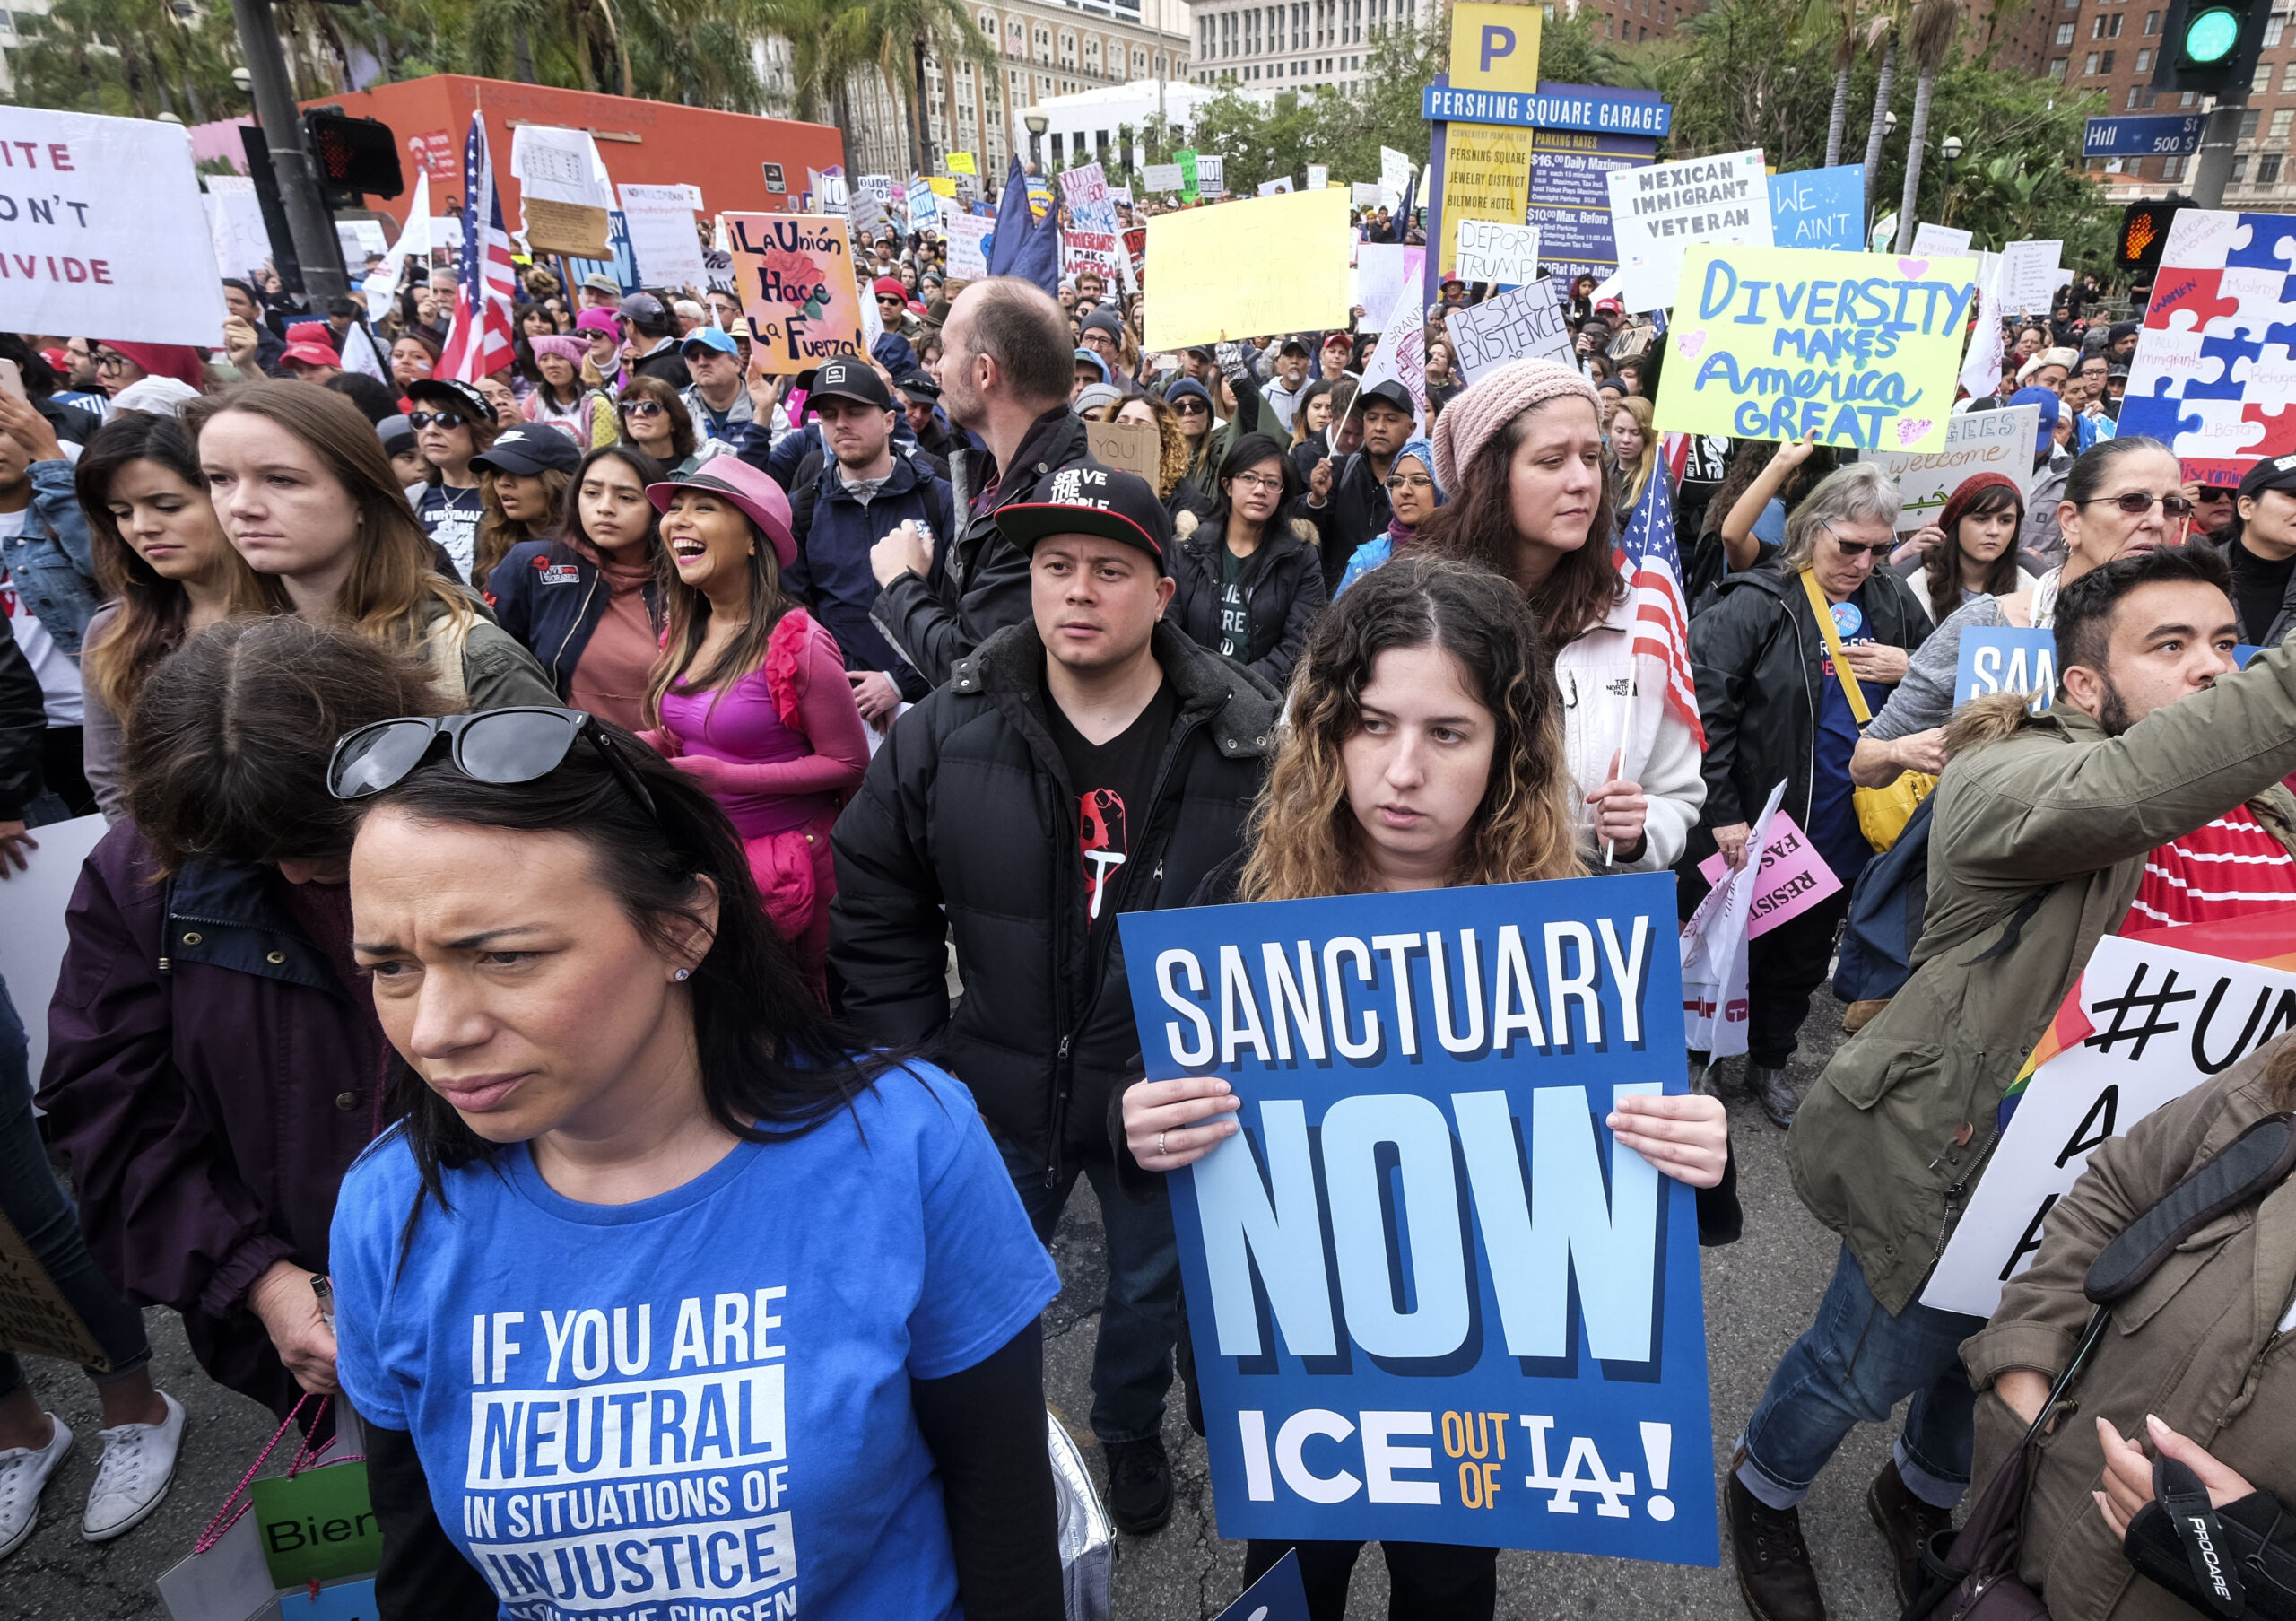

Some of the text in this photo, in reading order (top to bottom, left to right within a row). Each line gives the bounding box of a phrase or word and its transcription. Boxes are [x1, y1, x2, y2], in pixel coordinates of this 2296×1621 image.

[1480, 25, 1516, 72] P
[1431, 92, 1664, 130] PERSHING SQUARE GARAGE
[1535, 133, 1597, 149] PARKING RATES
[2087, 118, 2198, 146] Hill St
[2153, 136, 2194, 152] 500 S
[0, 140, 74, 171] ITE
[1450, 148, 1526, 165] PERSHING SQUARE
[1564, 155, 1586, 171] Daily
[1588, 157, 1632, 171] Maximum
[860, 179, 890, 188] DUDE
[1449, 171, 1485, 186] JEWELRY
[1488, 174, 1525, 187] DISTRICT
[1639, 161, 1733, 191] MEXICAN
[1448, 195, 1514, 211] BILTMORE HOTEL
[1633, 180, 1748, 214] IMMIGRANT
[1777, 180, 1816, 214] WE
[1556, 210, 1578, 223] Max.
[1579, 211, 1608, 225] Before
[1647, 209, 1749, 238] VETERAN
[1796, 214, 1850, 240] AIN'T
[1065, 230, 1116, 253] IMMIGRANTS
[1461, 222, 1540, 255] DEPORT
[0, 252, 114, 285] IVIDE
[1066, 259, 1116, 280] AMERICA
[1074, 249, 1105, 262] make
[1457, 253, 1535, 283] TRUMP
[1552, 263, 1567, 275] Flat
[1592, 266, 1613, 277] After
[757, 267, 831, 305] Hace
[1700, 259, 1973, 337] DIVERSITY
[2152, 277, 2197, 313] WOMEN
[2227, 279, 2279, 299] Muslims
[1454, 277, 1552, 341] RESPECT
[785, 315, 862, 360] Fuerza!
[1458, 303, 1566, 370] EXISTENCE
[1613, 330, 1636, 355] NO
[1773, 327, 1900, 366] MAKES
[2139, 345, 2204, 371] Immigrants
[1695, 351, 1923, 408] America
[1735, 396, 1900, 449] GREAT
[1095, 438, 1135, 459] YOU
[1889, 445, 2011, 475] welcome
[1050, 482, 1082, 501] THE
[1053, 468, 1108, 487] SERVE
[1751, 870, 1818, 920] RESIST
[1154, 915, 1649, 1068] SANCTUARY
[1187, 1080, 1663, 1362] NOW
[471, 1285, 787, 1384] IF YOU ARE
[480, 1379, 773, 1480] NEUTRAL
[1238, 1409, 1676, 1522] ICE OUT OF LA!
[464, 1465, 789, 1538] IN SITUATIONS OF
[485, 1523, 782, 1601] INJUSTICE
[2188, 1516, 2231, 1601] PROCARE
